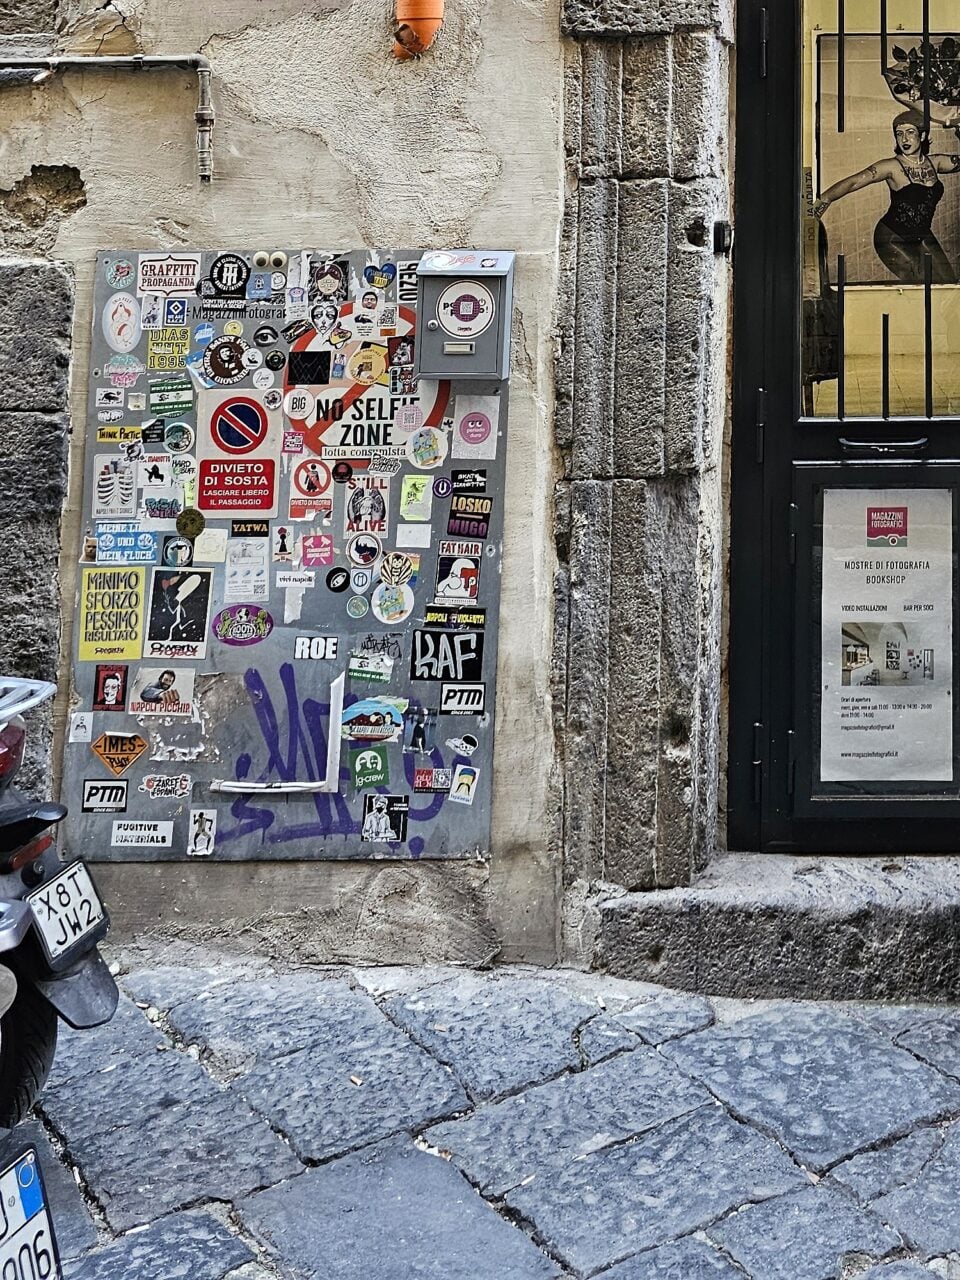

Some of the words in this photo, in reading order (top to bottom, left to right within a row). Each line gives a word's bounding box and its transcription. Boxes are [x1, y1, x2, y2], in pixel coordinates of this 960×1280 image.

[141, 264, 196, 277] GRAFFITI
[141, 277, 195, 287] PROPAGANDA
[150, 329, 188, 341] DIAS
[149, 356, 187, 368] 1995
[291, 396, 307, 410] BIG
[316, 398, 344, 422] NO
[98, 428, 117, 440] THINK
[119, 427, 141, 440] POETIC
[339, 423, 393, 447] ZONE
[466, 427, 486, 435] periodo
[324, 447, 346, 457] lotta
[171, 460, 191, 469] HARD
[210, 463, 264, 474] DIVIETO
[204, 476, 218, 486] DI
[224, 475, 268, 486] SOSTA
[348, 477, 388, 490] SILL
[203, 489, 240, 497] LASCIARE
[218, 498, 262, 506] PASSAGGIO
[451, 496, 492, 513] LOSKO
[871, 512, 904, 520] MAGAZZINI
[97, 524, 131, 533] MEINE
[233, 523, 268, 533] YATWA
[346, 520, 386, 532] ALIVE
[448, 519, 488, 535] MUGO
[871, 520, 904, 528] FOTOGRAFICI
[117, 537, 134, 547] UND
[441, 542, 455, 554] FAT
[98, 551, 122, 560] MEIN
[844, 561, 873, 570] MOSTRE
[875, 561, 883, 570] DI
[885, 560, 930, 570] FOTOGRAFIA
[87, 571, 140, 591] MINIMO
[866, 575, 906, 585] BOOKSHOP
[85, 591, 141, 611] SFORZO
[84, 610, 140, 631] PESSIMO
[84, 630, 138, 642] RISULTATO
[294, 636, 338, 660] ROE
[443, 688, 483, 706] PTM
[130, 702, 157, 712] NAPOLI
[159, 701, 190, 713] PICCHIA
[86, 785, 125, 803] PTM
[116, 823, 159, 832] FUGITIVE
[115, 834, 167, 844] MATERIALS
[39, 871, 82, 921] X8T
[56, 899, 97, 945] JW2
